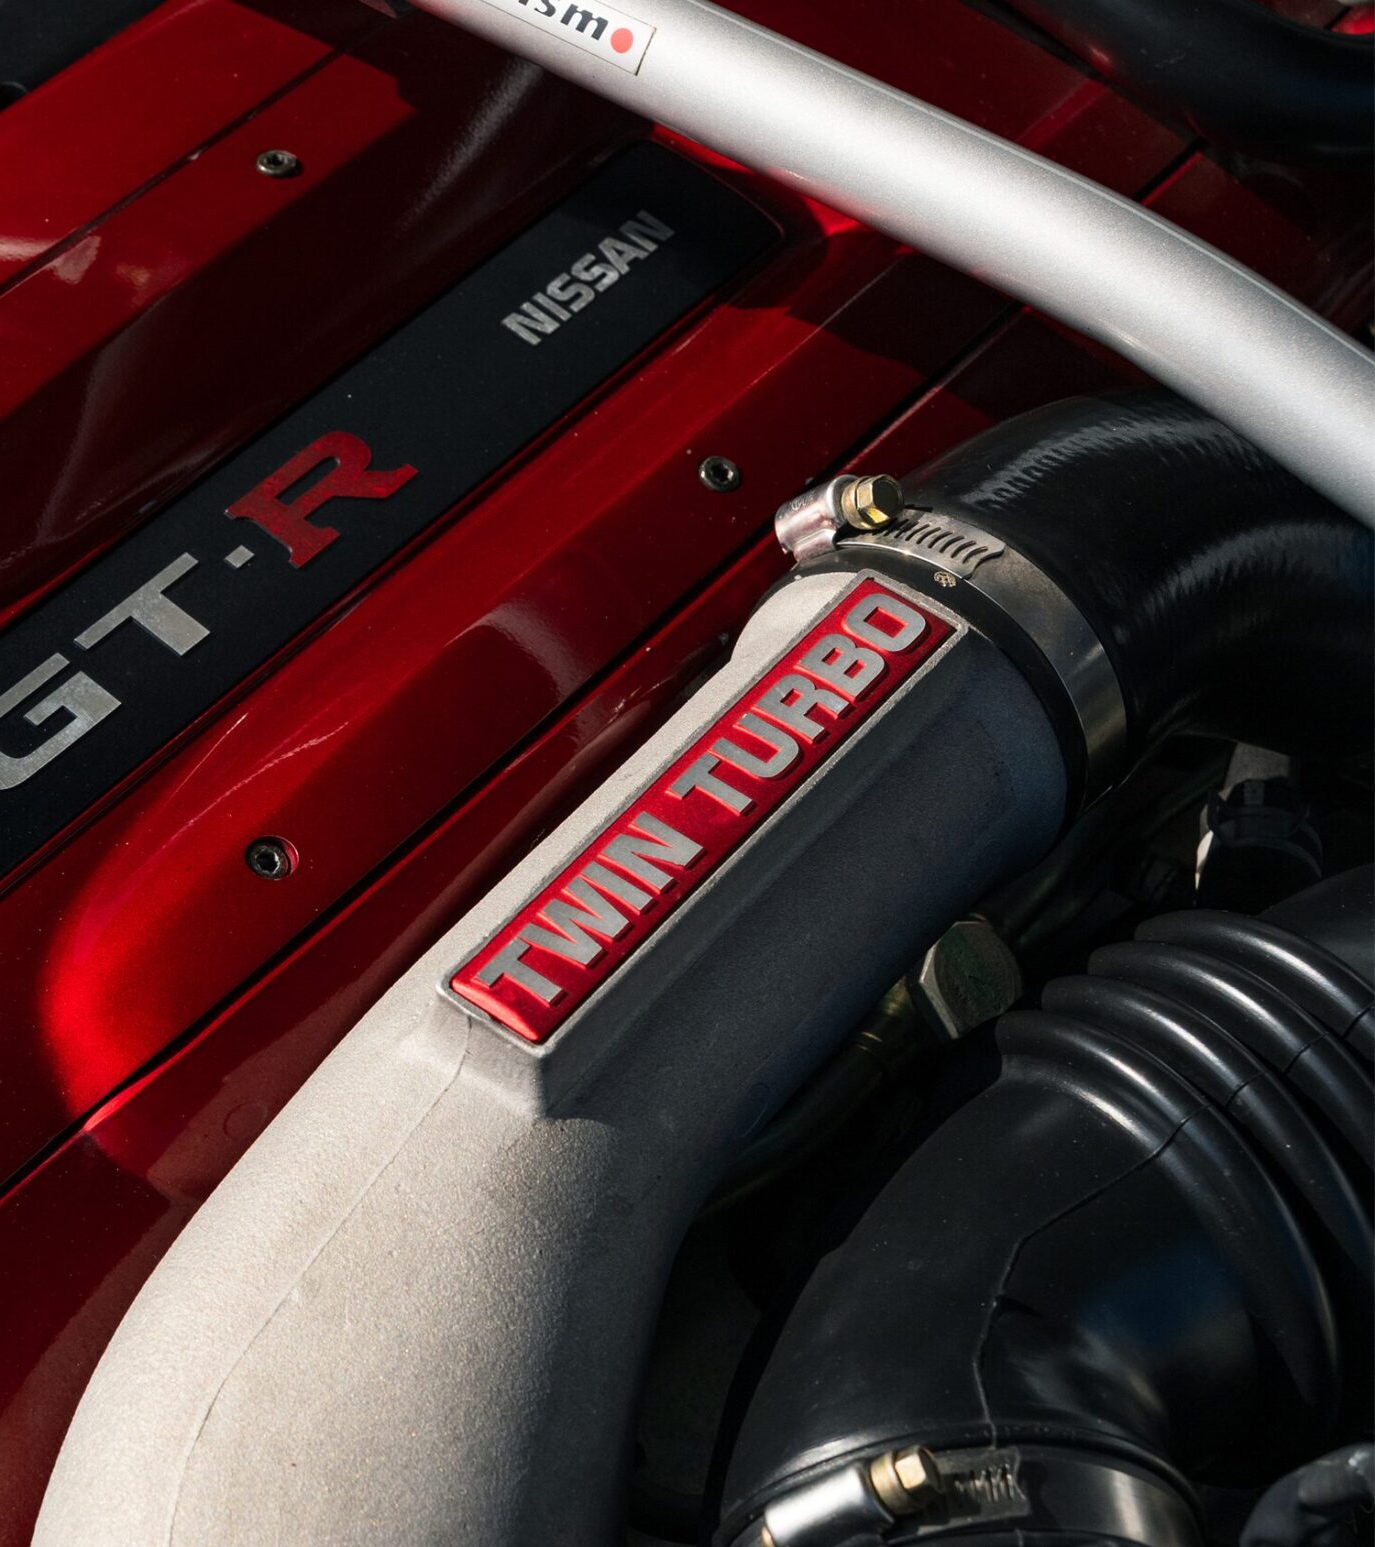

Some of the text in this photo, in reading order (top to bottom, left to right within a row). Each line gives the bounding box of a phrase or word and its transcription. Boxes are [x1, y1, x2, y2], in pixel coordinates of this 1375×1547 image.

[502, 212, 674, 345] NISSAN
[478, 592, 927, 1007] TWIN TURBO
